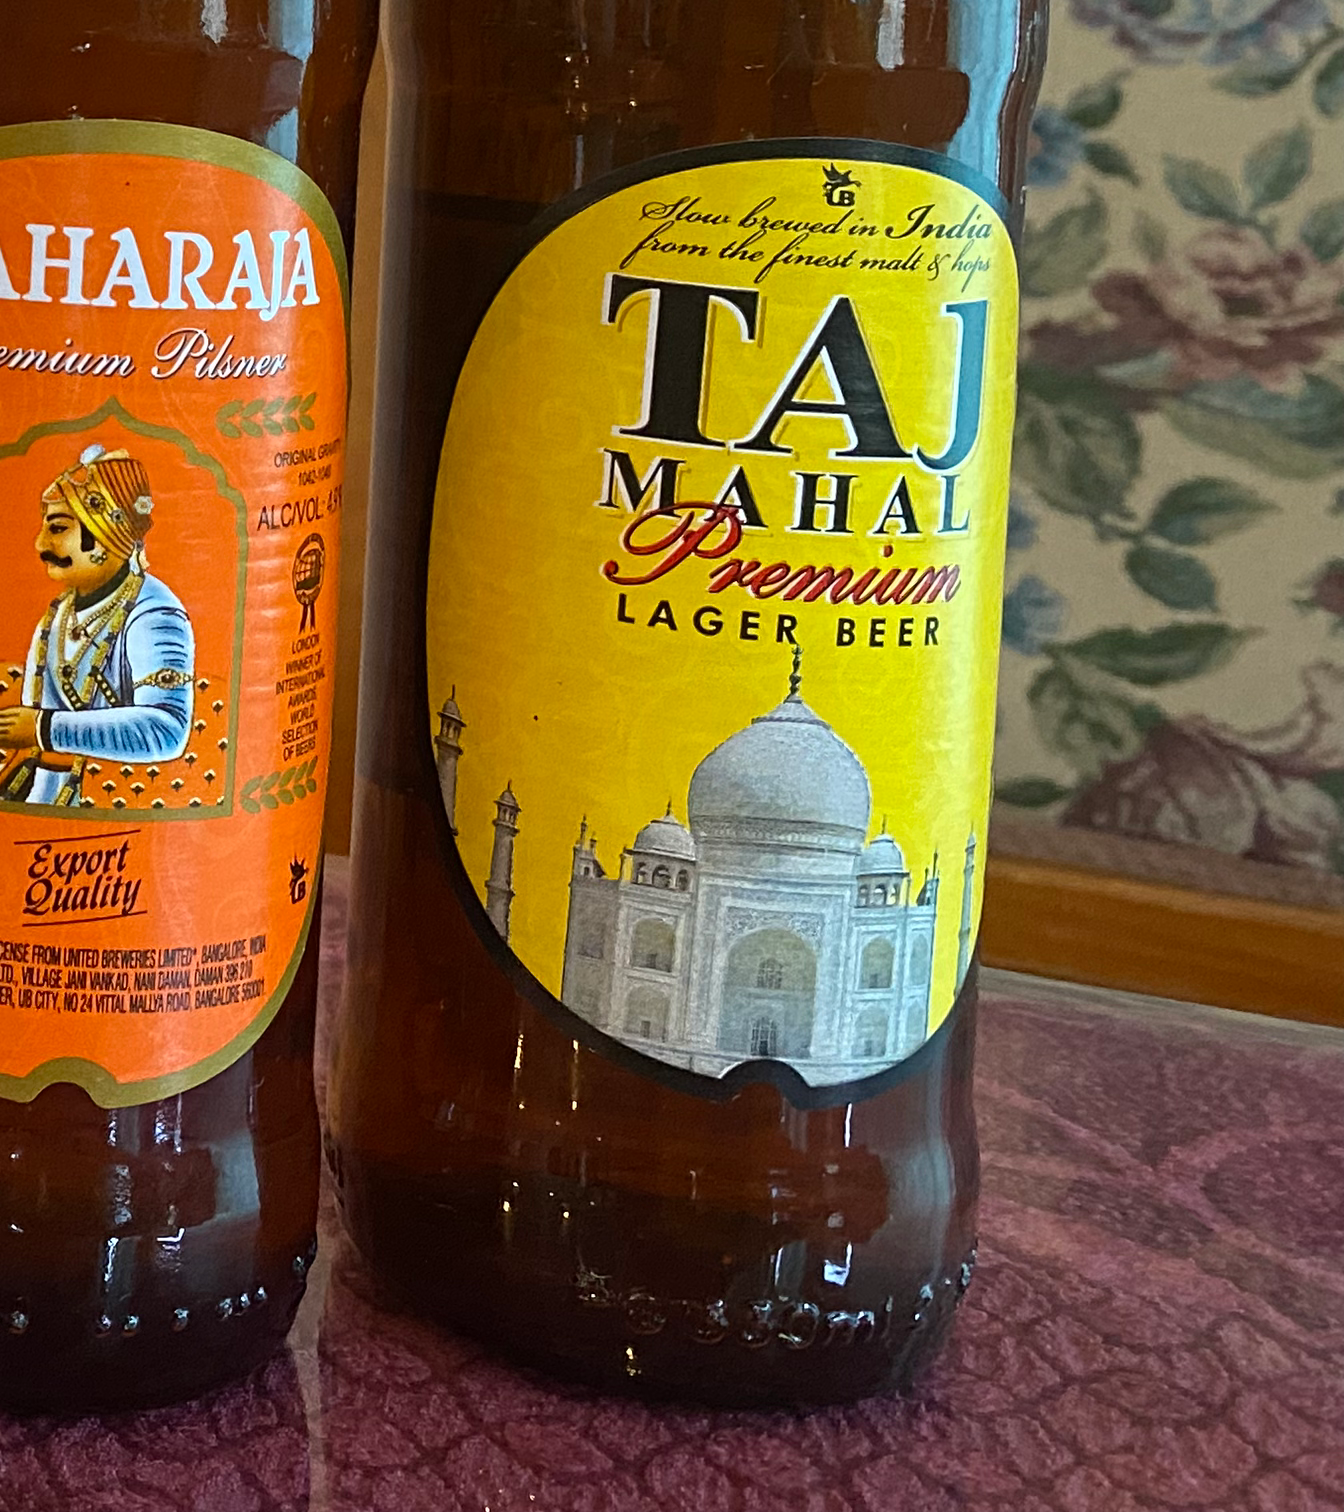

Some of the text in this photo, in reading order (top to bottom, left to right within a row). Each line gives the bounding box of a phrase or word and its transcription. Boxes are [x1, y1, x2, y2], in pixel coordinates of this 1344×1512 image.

[639, 196, 993, 239] Slow brewed in India
[620, 220, 991, 293] from the finest malt & hops
[151, 327, 288, 380] Pilsner
[602, 272, 989, 472] TAJ
[596, 448, 971, 536] MAHAL
[600, 500, 962, 605] Premium
[617, 594, 940, 648] LAGER BEER
[28, 840, 131, 885] Export
[22, 875, 142, 916] Quality
[22, 966, 61, 988] VILLAGE
[195, 964, 223, 987] DAMAN
[32, 944, 61, 965] FROM
[63, 947, 99, 968] UNITED
[102, 949, 156, 969] BREWERIES
[19, 989, 32, 1008] UB
[63, 992, 78, 1012] NO
[80, 993, 92, 1013] 24
[95, 994, 126, 1013] VITTAL
